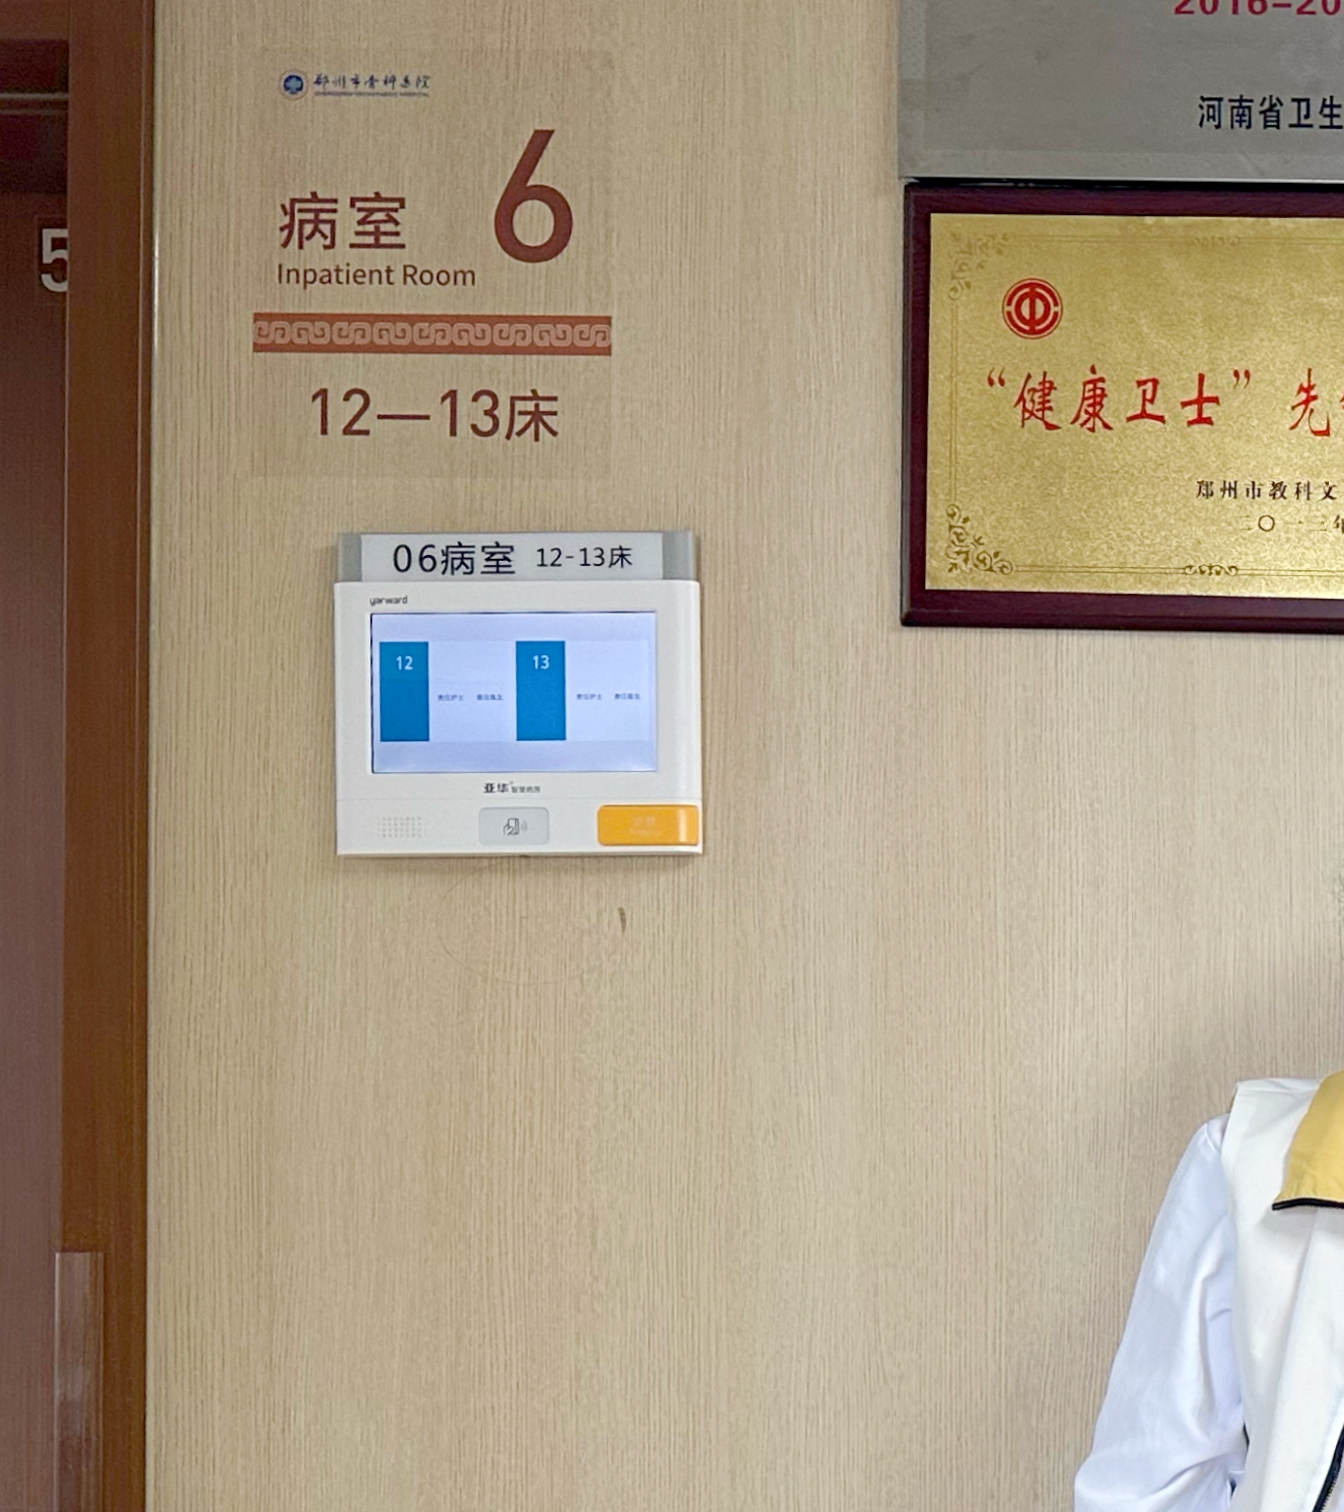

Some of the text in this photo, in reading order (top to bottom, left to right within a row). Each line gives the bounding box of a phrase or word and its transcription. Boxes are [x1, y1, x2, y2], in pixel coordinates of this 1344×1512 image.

[494, 129, 573, 263] 6
[279, 191, 406, 250] 病室
[277, 262, 476, 289] Inpatient Room
[392, 541, 633, 576] 06病室 12-13床
[369, 594, 408, 606] yarward
[396, 655, 414, 670] 12
[532, 654, 550, 670] 13
